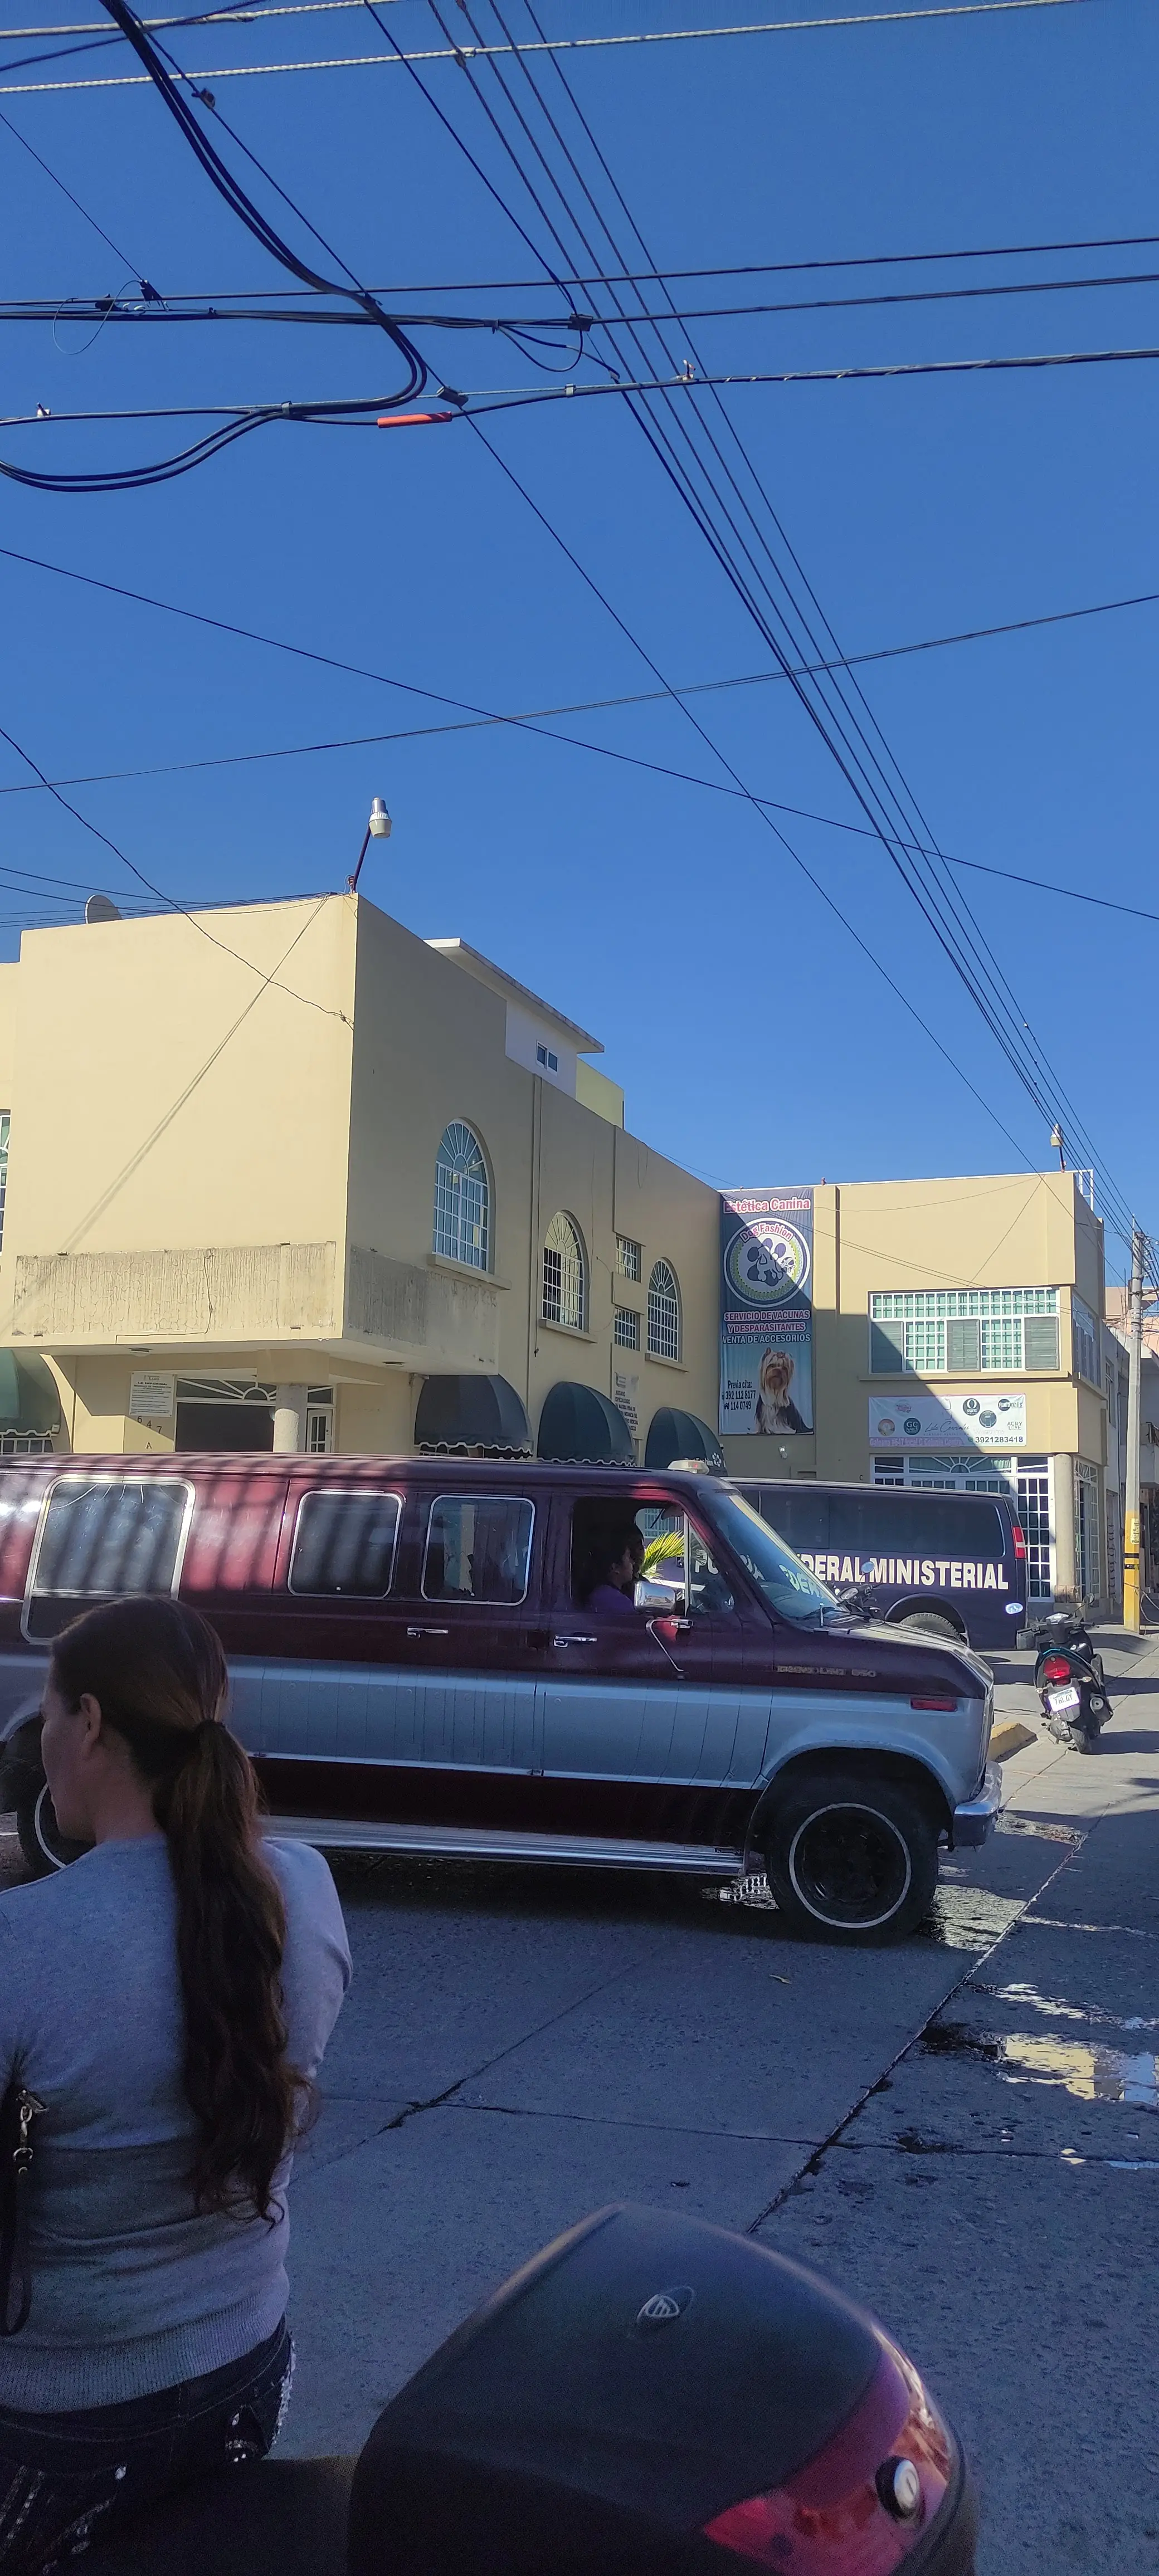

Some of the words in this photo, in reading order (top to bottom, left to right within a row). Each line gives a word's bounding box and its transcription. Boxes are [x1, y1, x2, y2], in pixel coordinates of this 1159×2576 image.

[724, 1199, 769, 1213] Estética
[770, 1197, 811, 1211] Canina
[740, 1226, 759, 1242] Dog
[759, 1223, 793, 1241] Fashion
[724, 1311, 760, 1321] SERVICIO
[761, 1311, 772, 1320] DE
[772, 1310, 810, 1320] VACUNAS
[728, 1324, 734, 1333] Y
[734, 1322, 806, 1333] DESPARASITANTES
[747, 1335, 758, 1343] DE
[759, 1334, 811, 1343] ACCESORIOS
[728, 1380, 741, 1389] Previa
[742, 1379, 752, 1388] cita:
[725, 1391, 734, 1399] 392
[744, 1390, 756, 1399] 8177
[731, 1402, 739, 1410] 114
[739, 1401, 751, 1409] 0749
[869, 1558, 1009, 1589] MINISTERIAL
